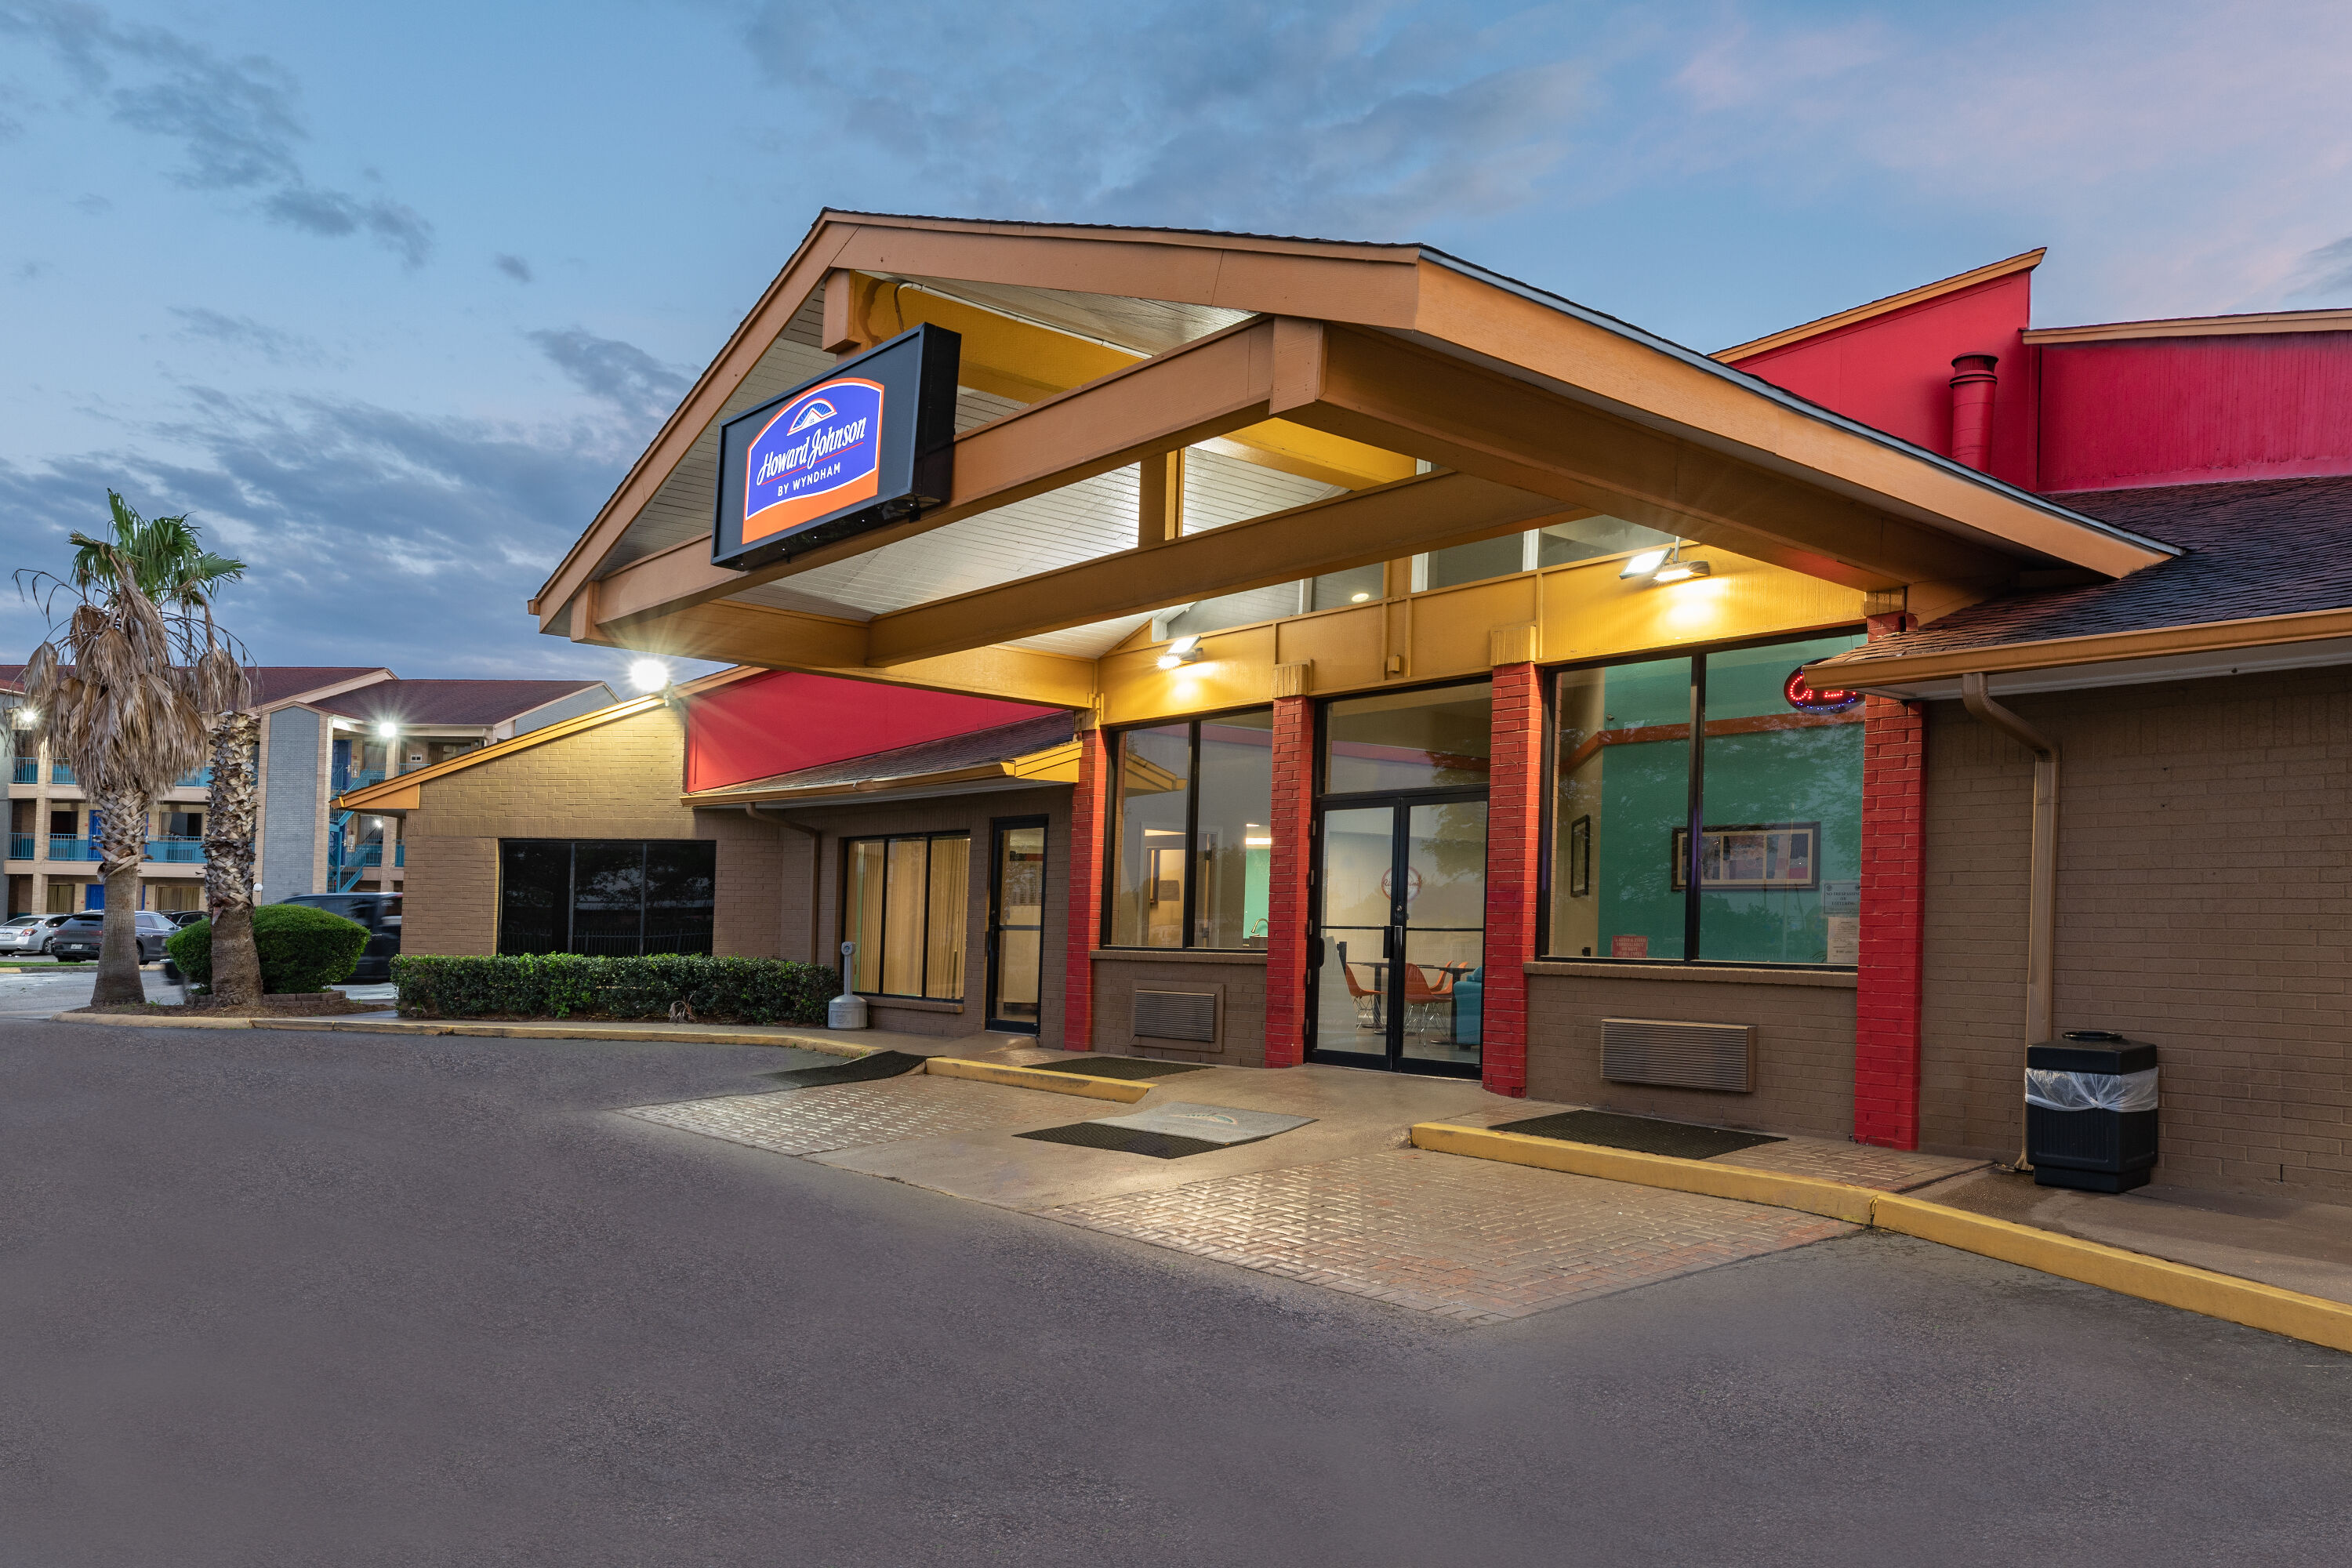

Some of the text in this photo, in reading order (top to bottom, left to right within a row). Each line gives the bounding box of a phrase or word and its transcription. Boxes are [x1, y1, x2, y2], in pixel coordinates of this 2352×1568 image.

[757, 417, 867, 486] Howard Johnson
[778, 462, 841, 497] BY WYNDHAM
